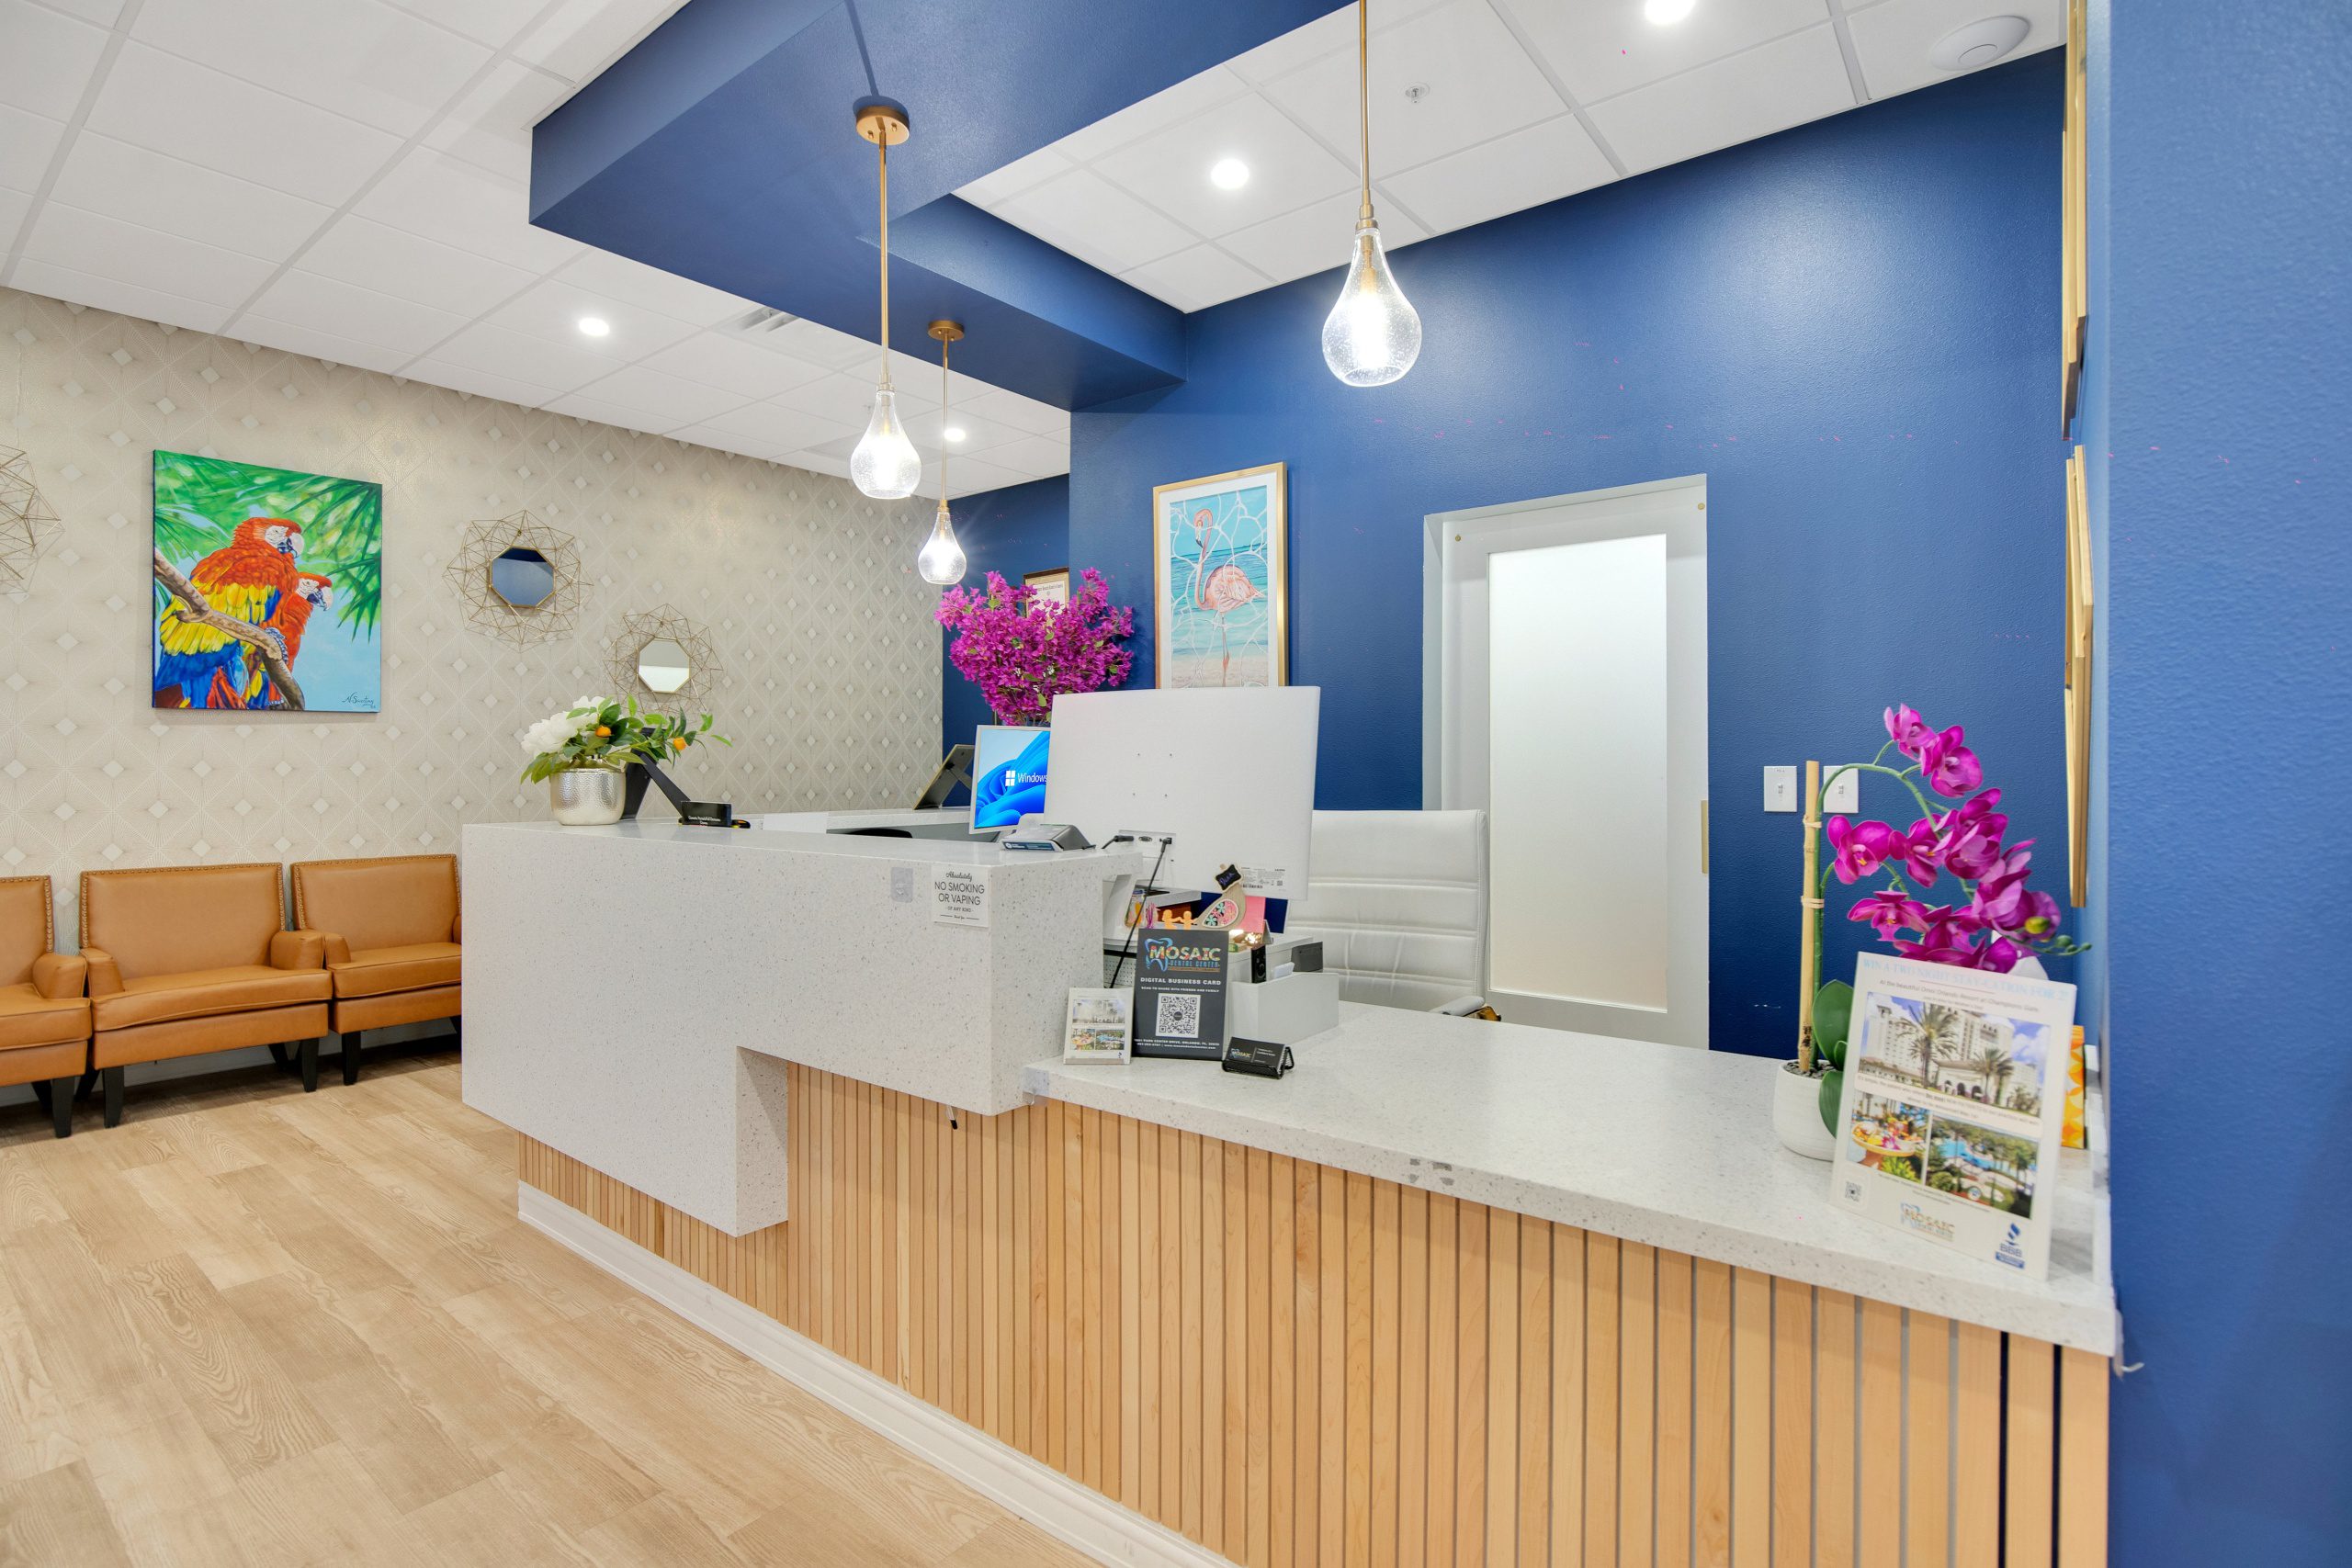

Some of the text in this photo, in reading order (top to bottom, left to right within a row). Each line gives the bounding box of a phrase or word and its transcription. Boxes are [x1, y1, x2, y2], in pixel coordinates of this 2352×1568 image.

[945, 871, 972, 882] Absolutely
[934, 881, 984, 894] NO SMOKING
[938, 893, 980, 905] OR VAPING
[1149, 945, 1221, 961] MOSAIC
[1863, 958, 1882, 971] WIN
